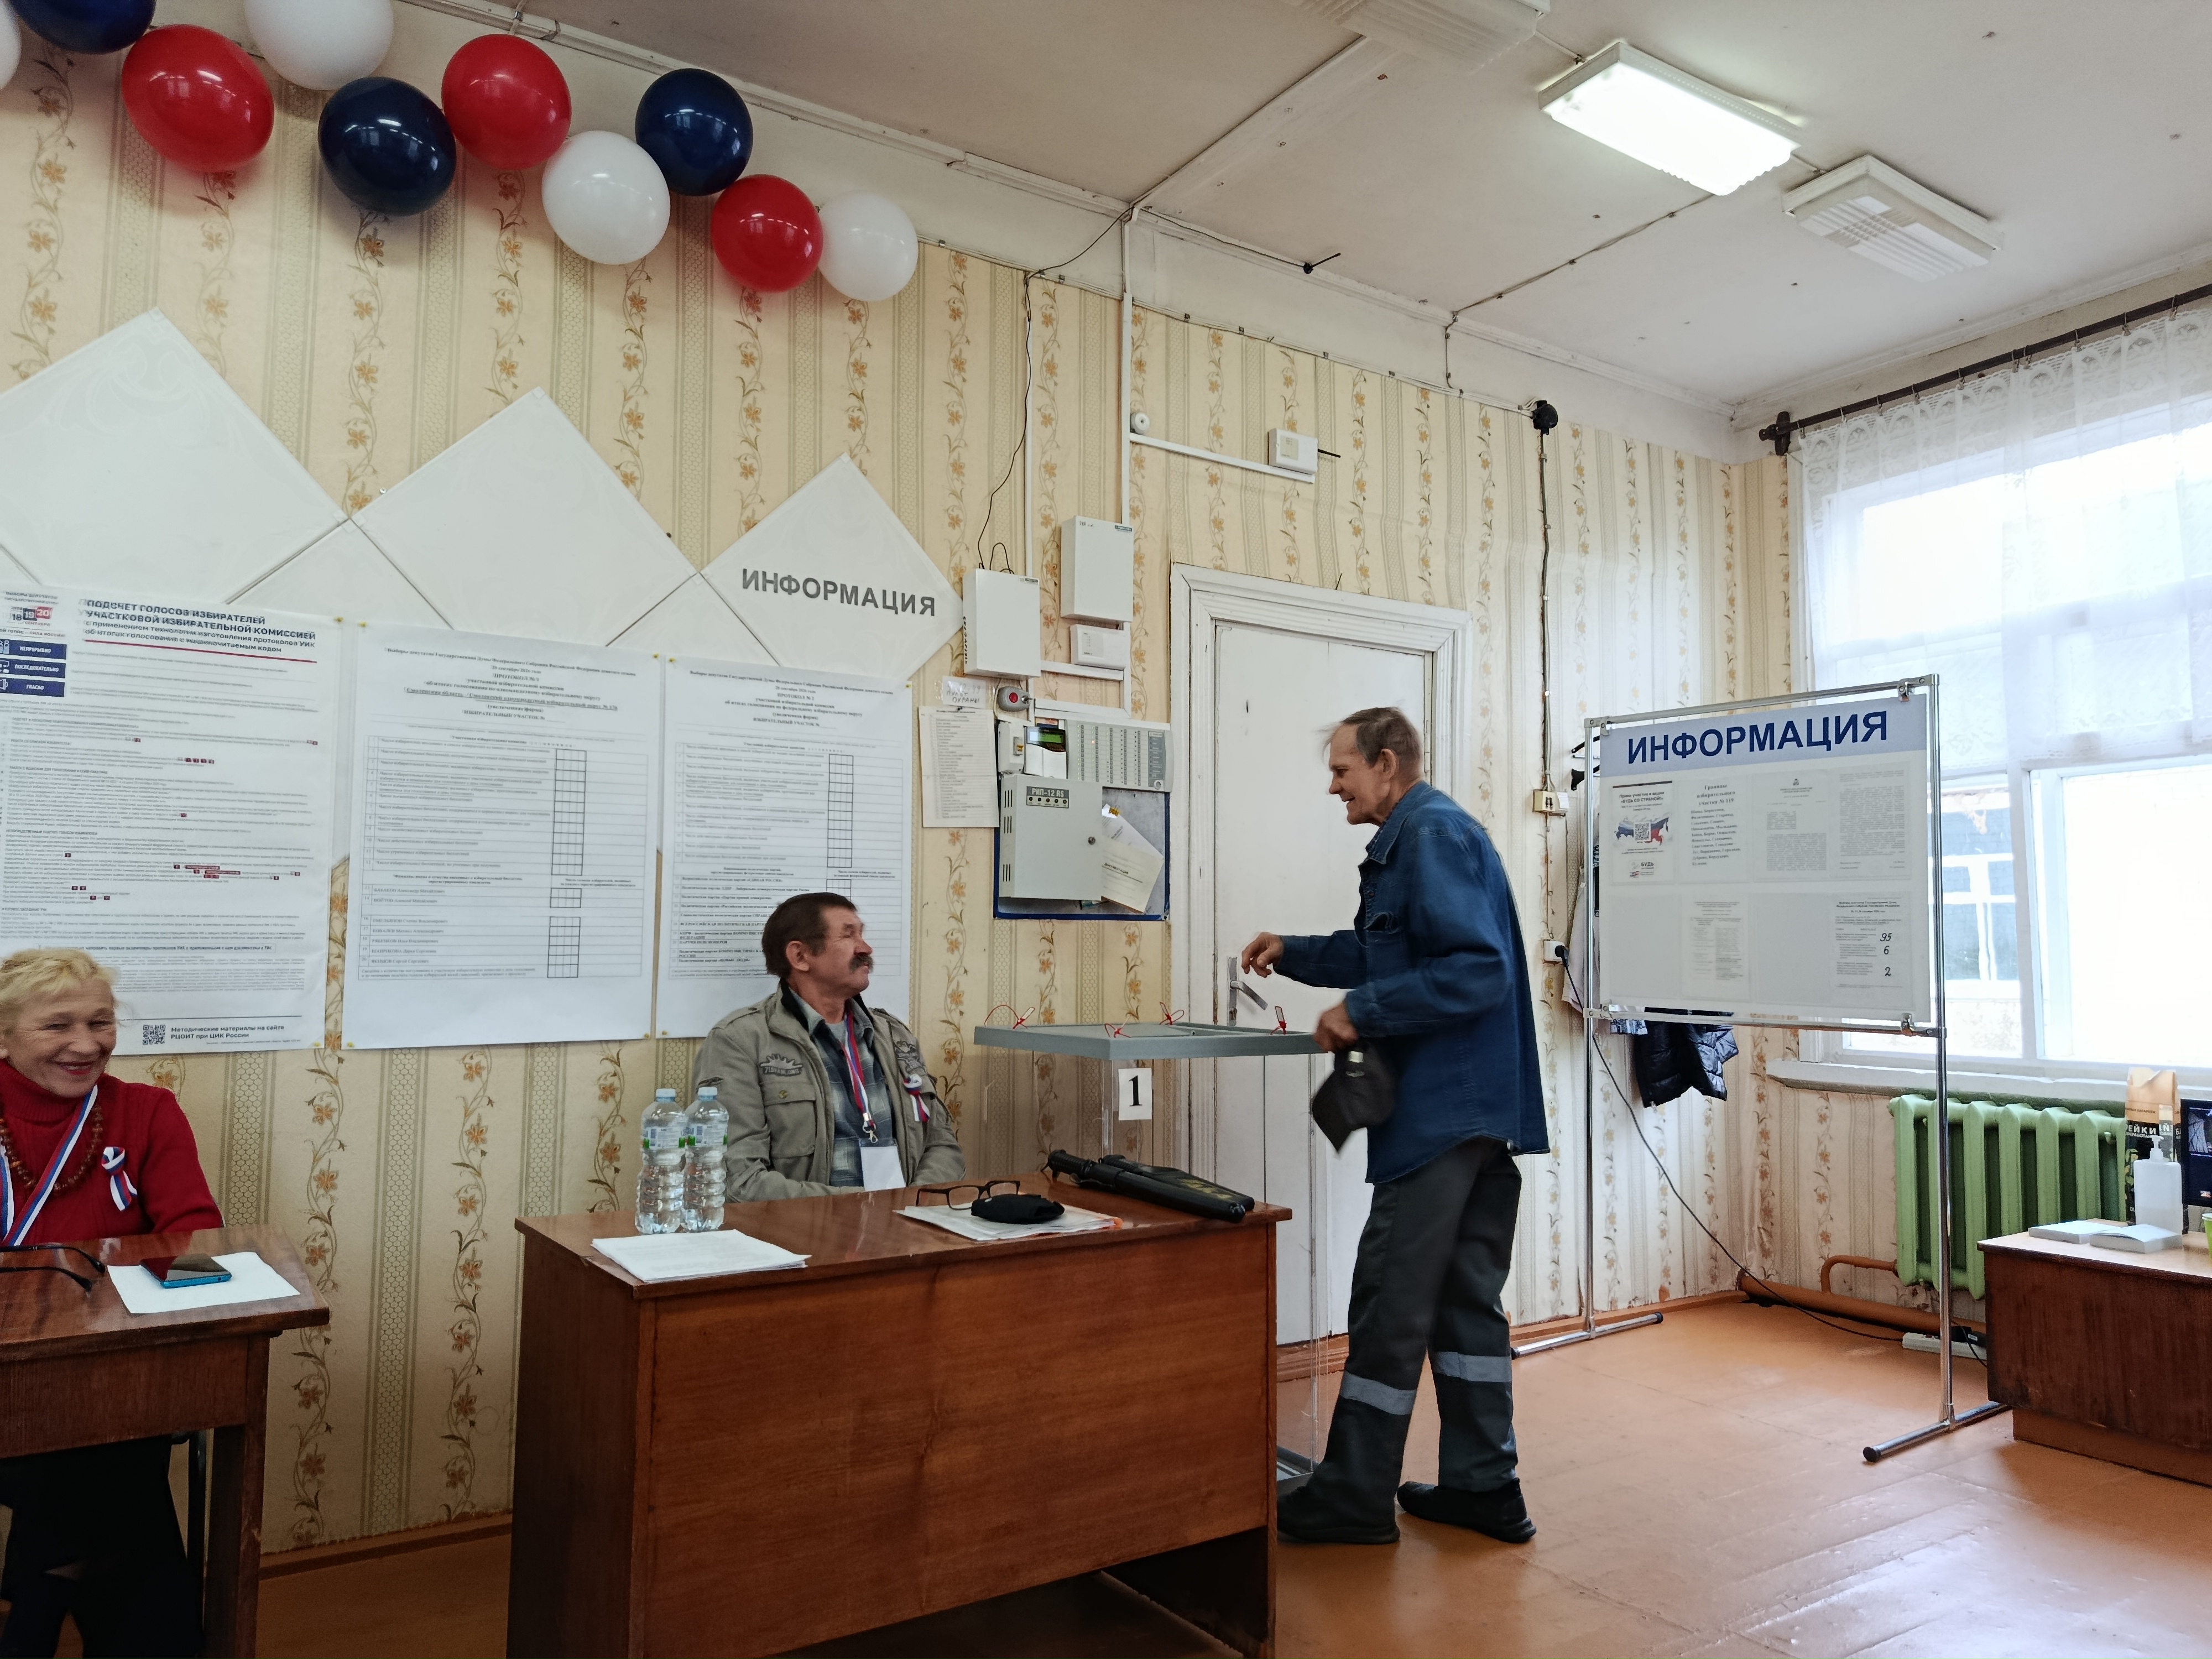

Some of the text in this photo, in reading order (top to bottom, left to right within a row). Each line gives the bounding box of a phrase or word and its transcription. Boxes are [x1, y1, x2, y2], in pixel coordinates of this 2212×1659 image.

[743, 568, 935, 617] ИНФОРМАЦИЯ
[87, 600, 265, 624] ПОДСЧЕТ ГОЛОСОВ ИЗБИРАТЕЛЕЙ
[86, 611, 316, 640] УЧАСТКОВОЙ ИЗБИРАТЕЛЬНОЙ КОМИССИЕЙ
[92, 622, 149, 631] применением
[253, 637, 298, 646] протоколов
[127, 633, 178, 642] голосования
[1628, 711, 1887, 764] ИНФОРМАЦИЯ
[1031, 788, 1055, 796] РИП-12
[1880, 932, 1892, 942] 95
[1884, 945, 1890, 954] 6
[1885, 967, 1891, 977] 2
[1129, 1075, 1142, 1107] 1
